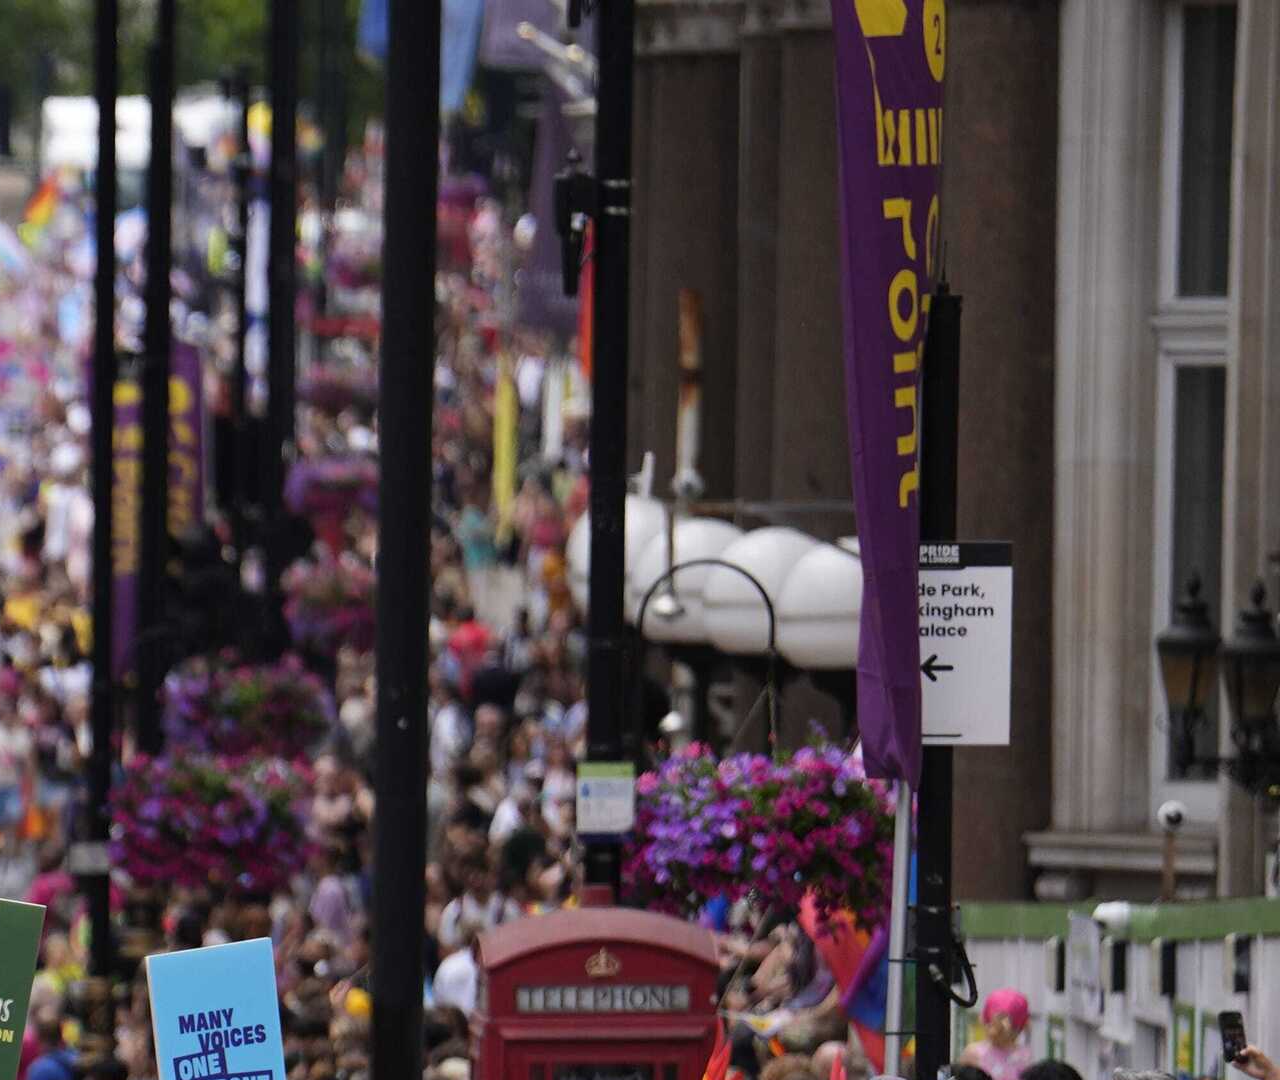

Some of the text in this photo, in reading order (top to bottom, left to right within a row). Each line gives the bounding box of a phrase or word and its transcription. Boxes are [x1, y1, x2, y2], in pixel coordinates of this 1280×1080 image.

[918, 583, 985, 599] de Park,
[919, 624, 968, 637] alace
[521, 987, 687, 1010] TELEPHONE
[178, 1008, 233, 1034] MANY
[198, 1024, 266, 1052] VOICES
[178, 1053, 221, 1080] ONE
